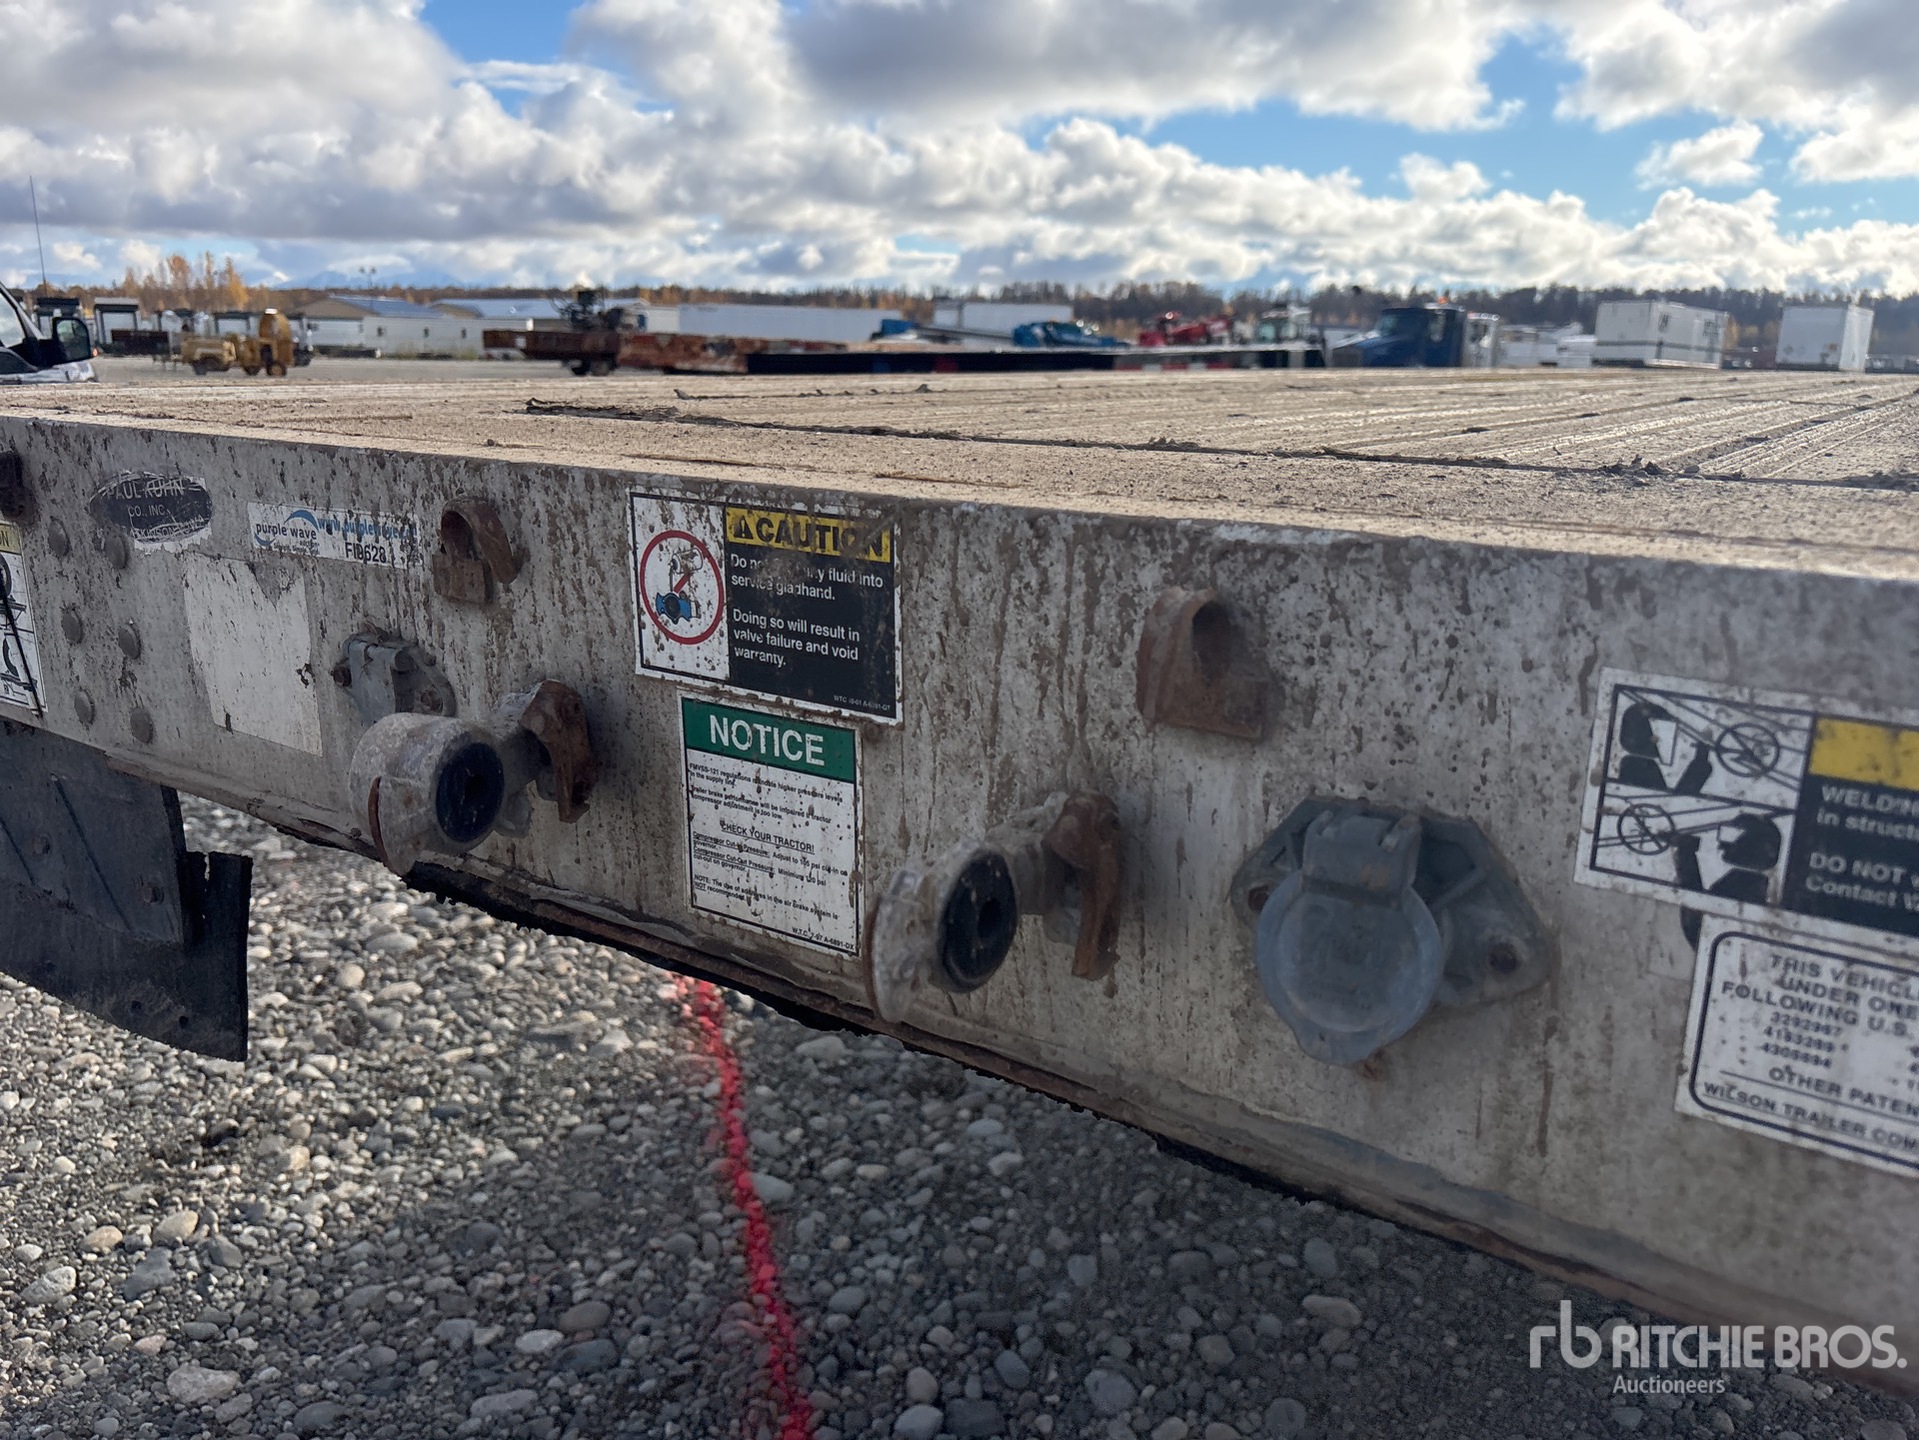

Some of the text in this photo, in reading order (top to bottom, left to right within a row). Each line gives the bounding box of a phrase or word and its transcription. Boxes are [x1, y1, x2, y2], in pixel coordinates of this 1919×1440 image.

[255, 522, 317, 540] purple wave
[756, 516, 883, 558] CAUTION
[730, 554, 748, 569] Do
[828, 568, 856, 584] fluid
[858, 573, 884, 588] into
[731, 574, 836, 601] service gladhand.
[733, 608, 860, 643] Doing so will result in
[733, 629, 859, 661] valve failure and void
[734, 647, 787, 669] warranty.
[709, 714, 826, 767] NOTICE
[1816, 806, 1841, 828] in
[721, 823, 815, 853] CHECK YOUR TRACTOR!
[792, 856, 799, 864] to
[1809, 851, 1848, 875] DO
[1851, 859, 1908, 886] NOT
[1805, 873, 1898, 908] Contact
[1769, 953, 1919, 1001] THIS VEHICL
[1779, 976, 1860, 1006] UNDER
[1721, 980, 1859, 1027] FOLLOWING
[1768, 1066, 1843, 1098] OTHER
[1703, 1080, 1777, 1113] WILSON
[1782, 1103, 1867, 1136] TRAILER
